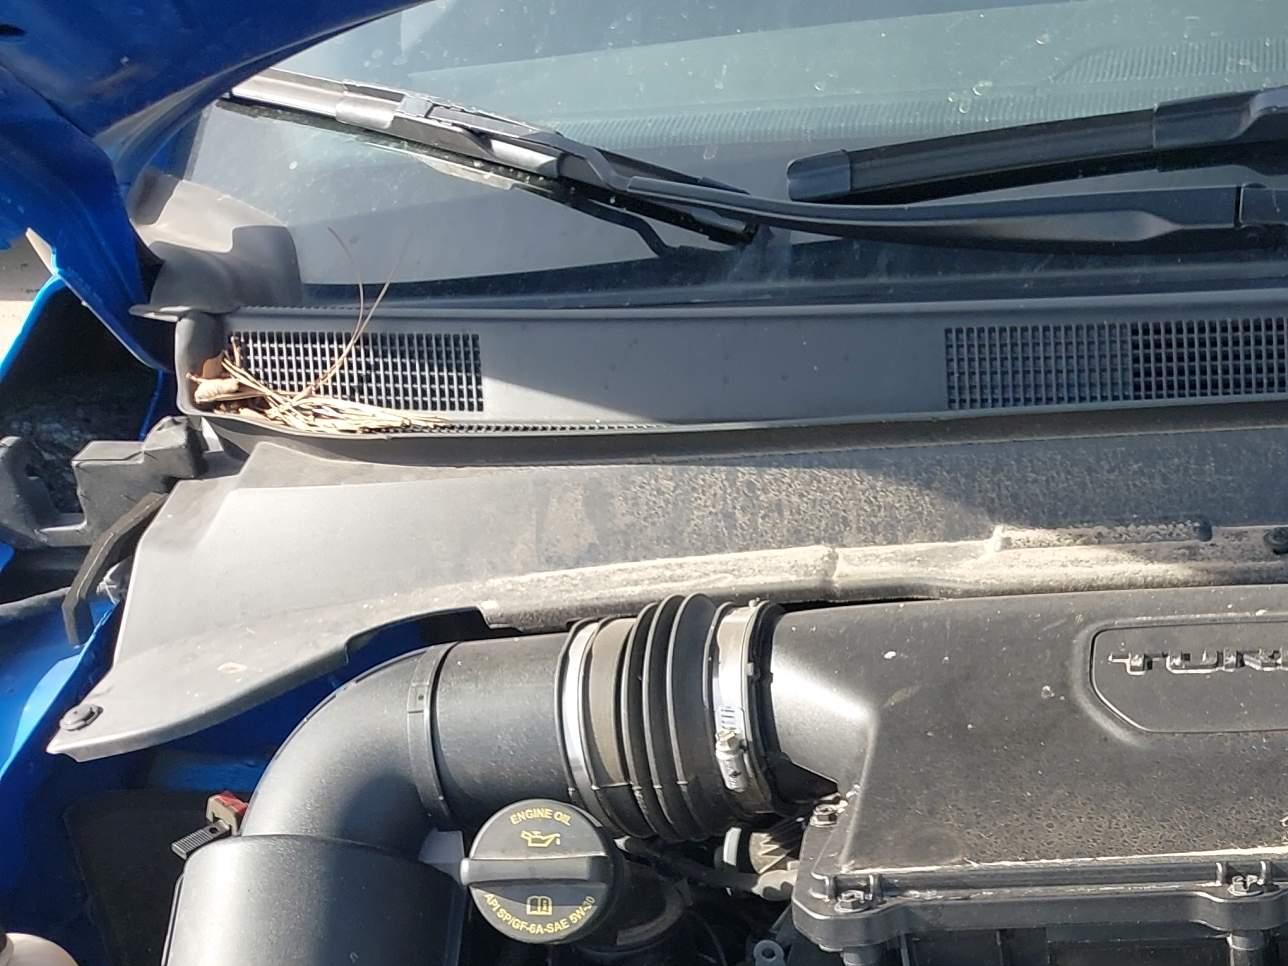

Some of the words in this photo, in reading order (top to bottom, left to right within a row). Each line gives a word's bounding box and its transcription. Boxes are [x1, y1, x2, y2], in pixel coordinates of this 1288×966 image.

[510, 807, 553, 825] ENGINE
[553, 811, 573, 826] OIL
[483, 892, 499, 913] API
